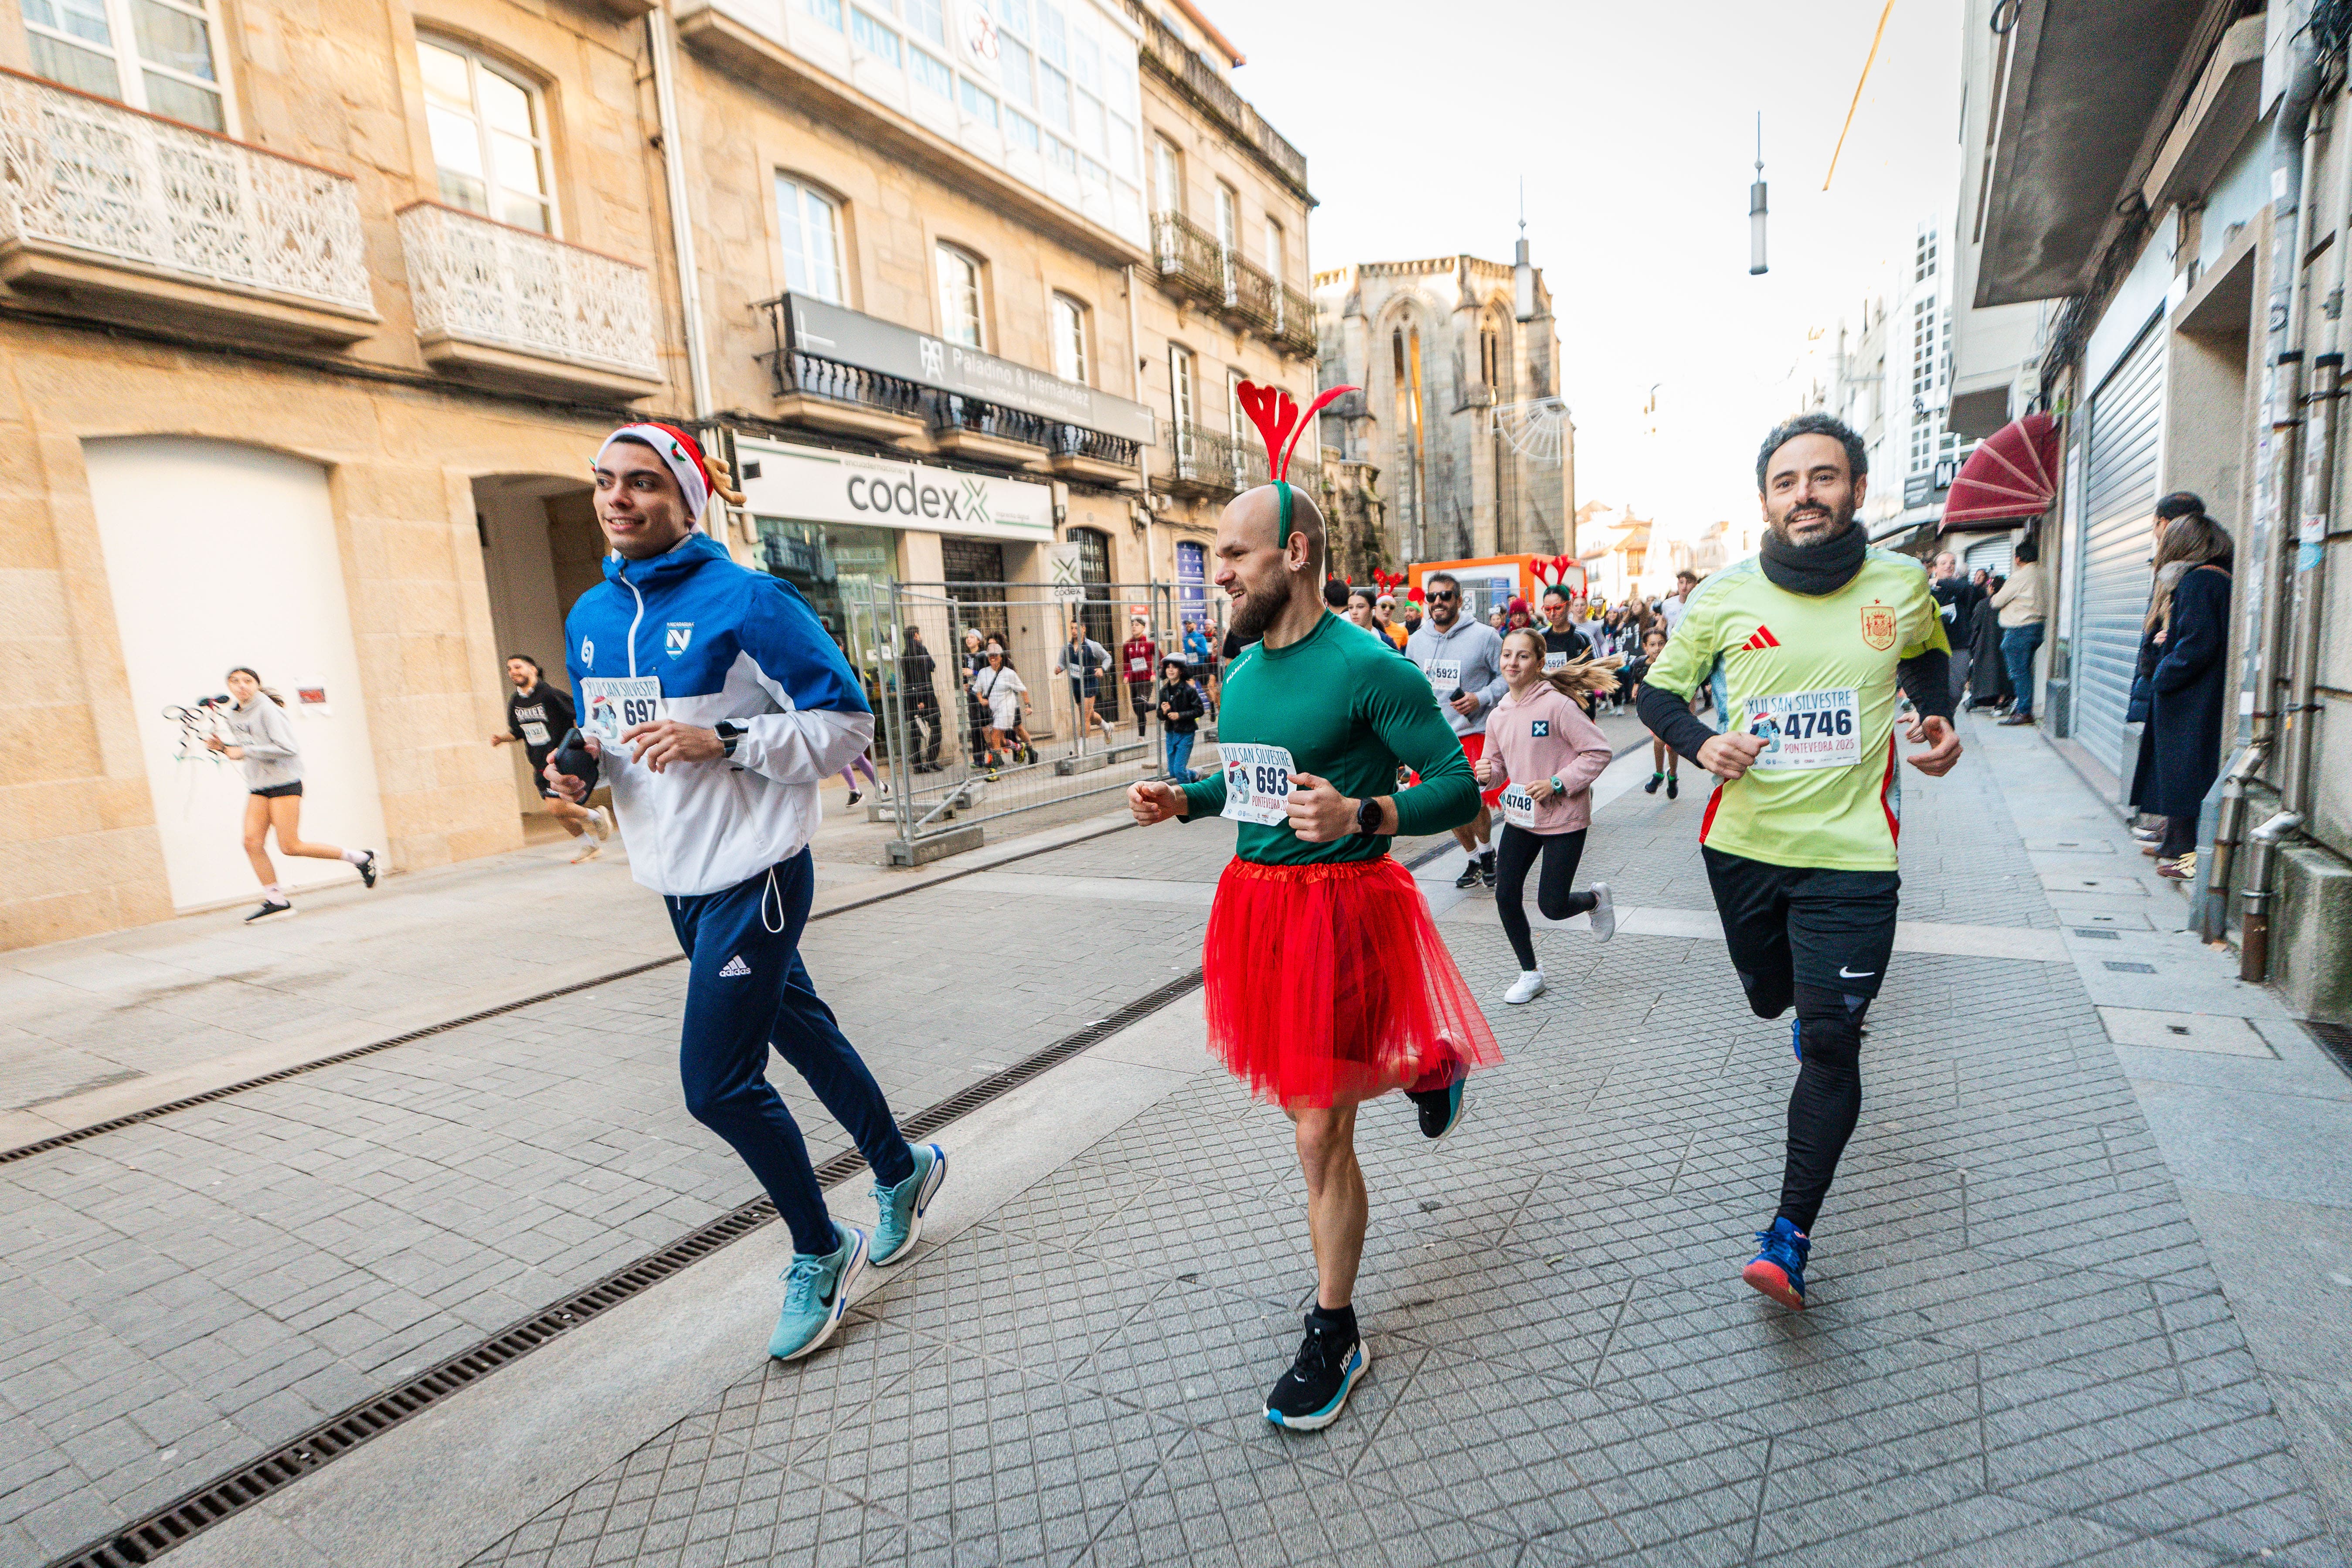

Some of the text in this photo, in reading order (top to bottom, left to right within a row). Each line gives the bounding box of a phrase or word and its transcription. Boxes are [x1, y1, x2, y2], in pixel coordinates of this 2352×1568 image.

[952, 347, 1089, 406] Paladino & Hernández
[846, 469, 962, 520] codex
[1054, 586, 1081, 596] codex
[1226, 653, 1252, 684] FUJIMAE
[1437, 667, 1458, 679] 5923
[602, 681, 621, 697] SAN
[619, 680, 658, 697] SILVESTRE
[1748, 690, 1852, 714] XLII SAN SILVESTRE
[624, 699, 656, 726] 697
[1784, 708, 1852, 739] 4746
[1785, 738, 1854, 754] PONTEVEDRA 2025
[1222, 747, 1291, 767] XLII SAN SILVESTRE
[1256, 766, 1288, 796] 693
[1510, 785, 1525, 795] SILVES
[1252, 796, 1280, 809] PONTEVEDRA
[1507, 793, 1532, 811] 4748
[719, 967, 751, 977] adidas
[1339, 1343, 1356, 1376] HOKA
